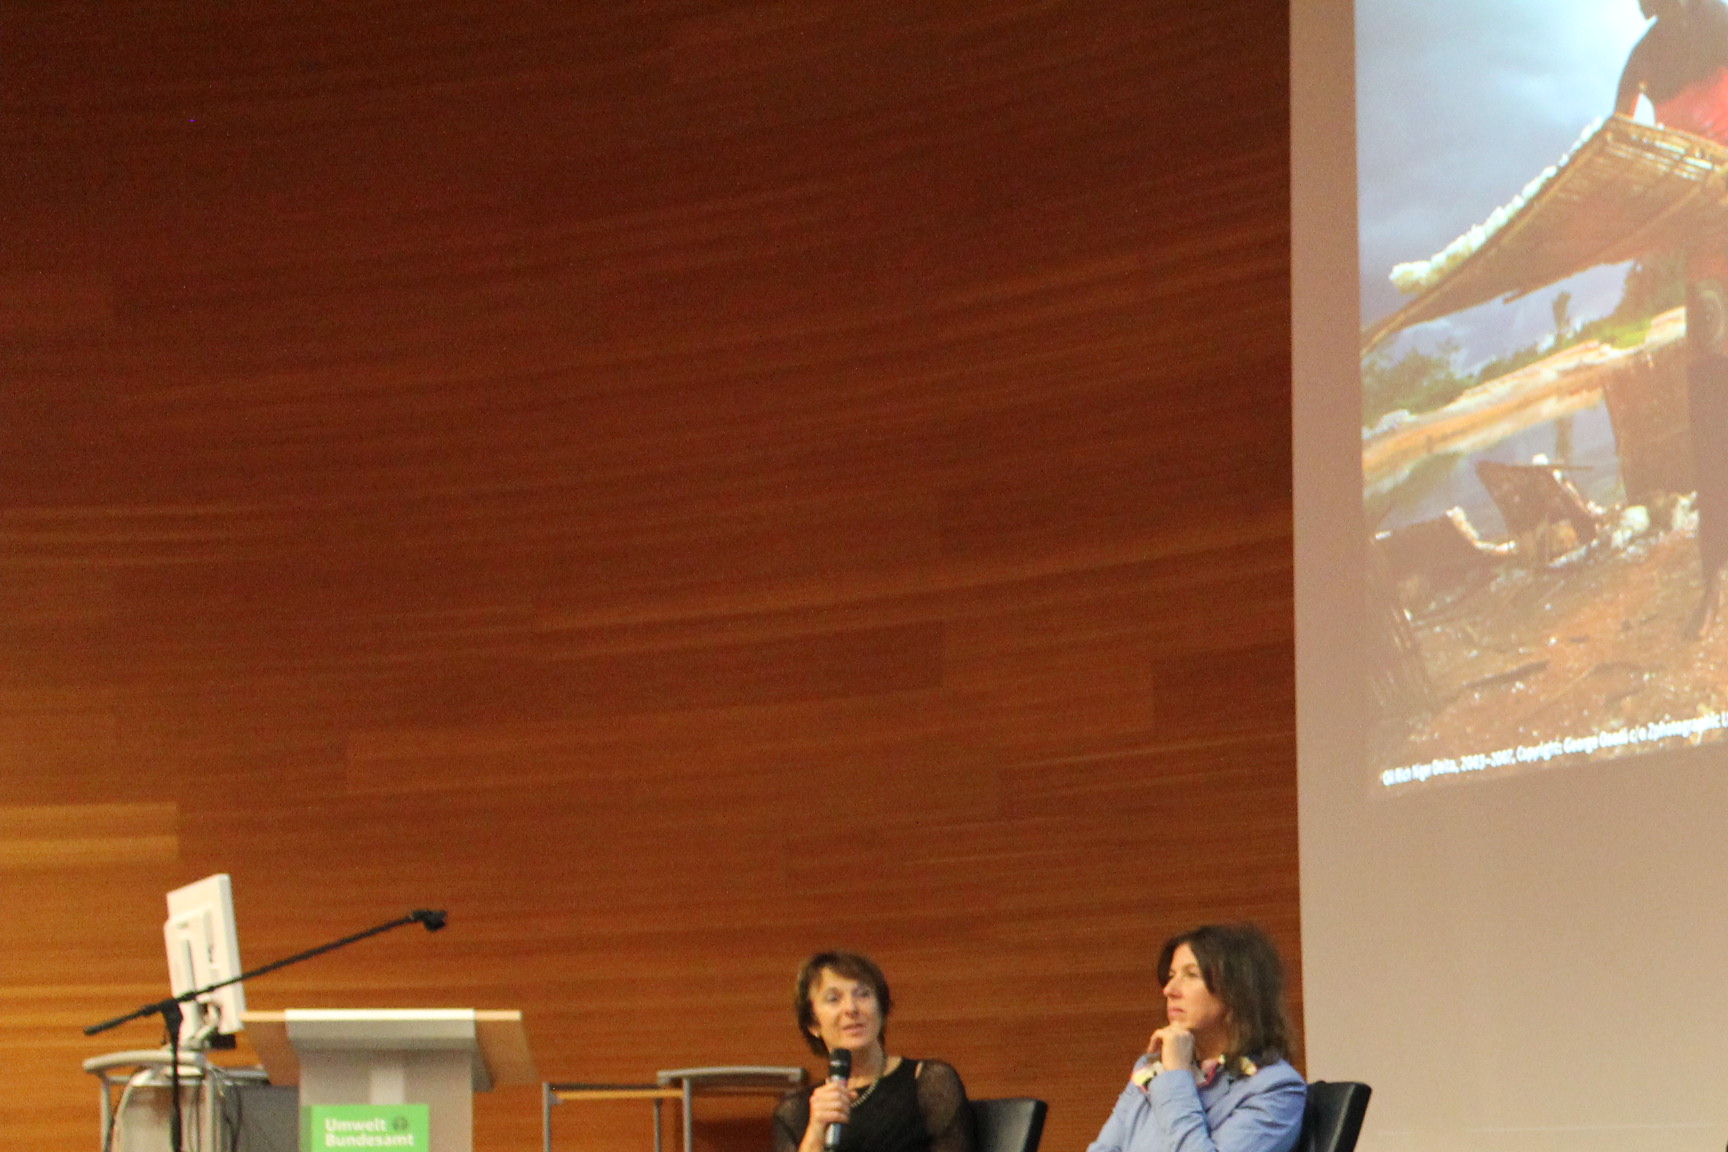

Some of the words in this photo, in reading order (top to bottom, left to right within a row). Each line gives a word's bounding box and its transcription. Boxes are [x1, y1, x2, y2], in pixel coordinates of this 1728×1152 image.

[1516, 740, 1562, 761] Copyright:
[1562, 735, 1599, 755] George
[325, 1117, 387, 1132] Umwelt
[325, 1132, 414, 1147] Bundesamt
